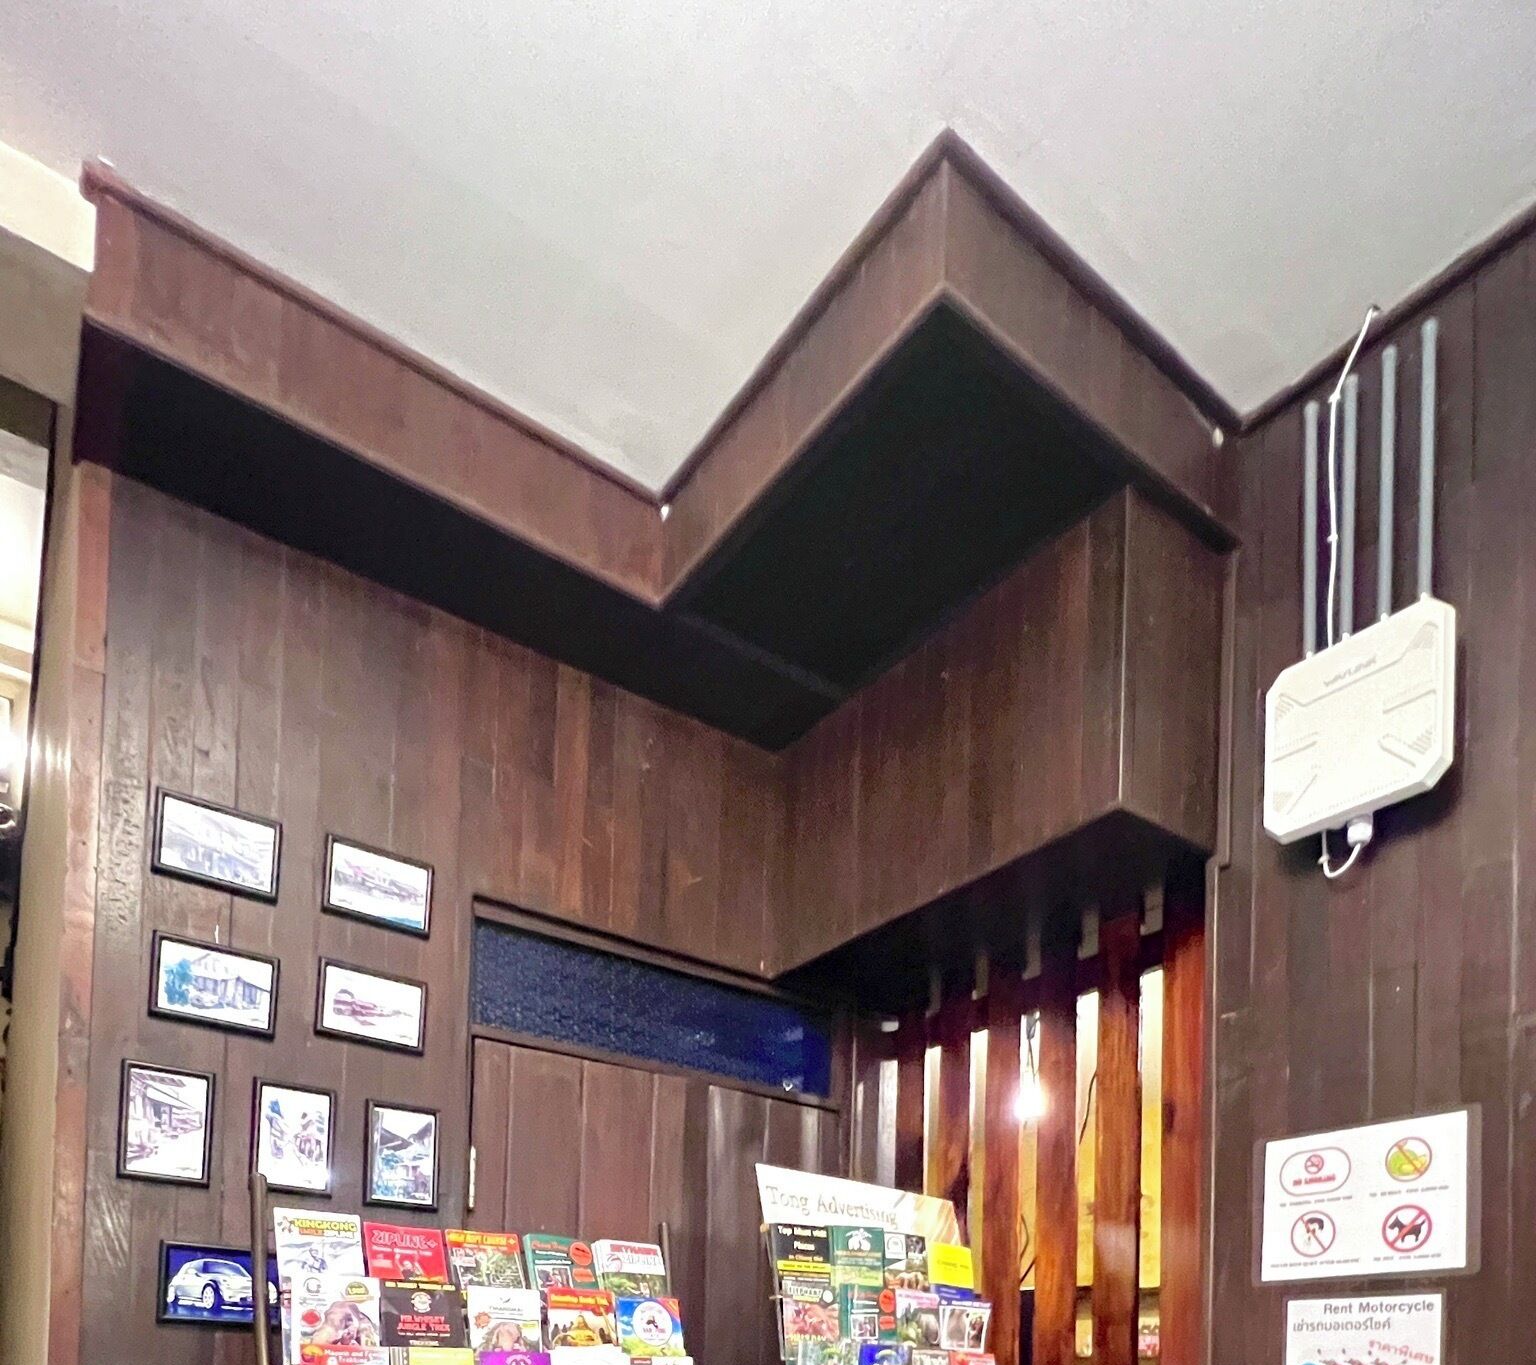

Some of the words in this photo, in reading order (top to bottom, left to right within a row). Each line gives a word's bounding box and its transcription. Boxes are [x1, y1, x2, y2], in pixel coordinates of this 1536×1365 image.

[766, 1185, 810, 1216] Tong
[817, 1194, 898, 1230] Advertising
[1323, 1302, 1353, 1315] Rent
[1358, 1300, 1435, 1315] Motorcycle
